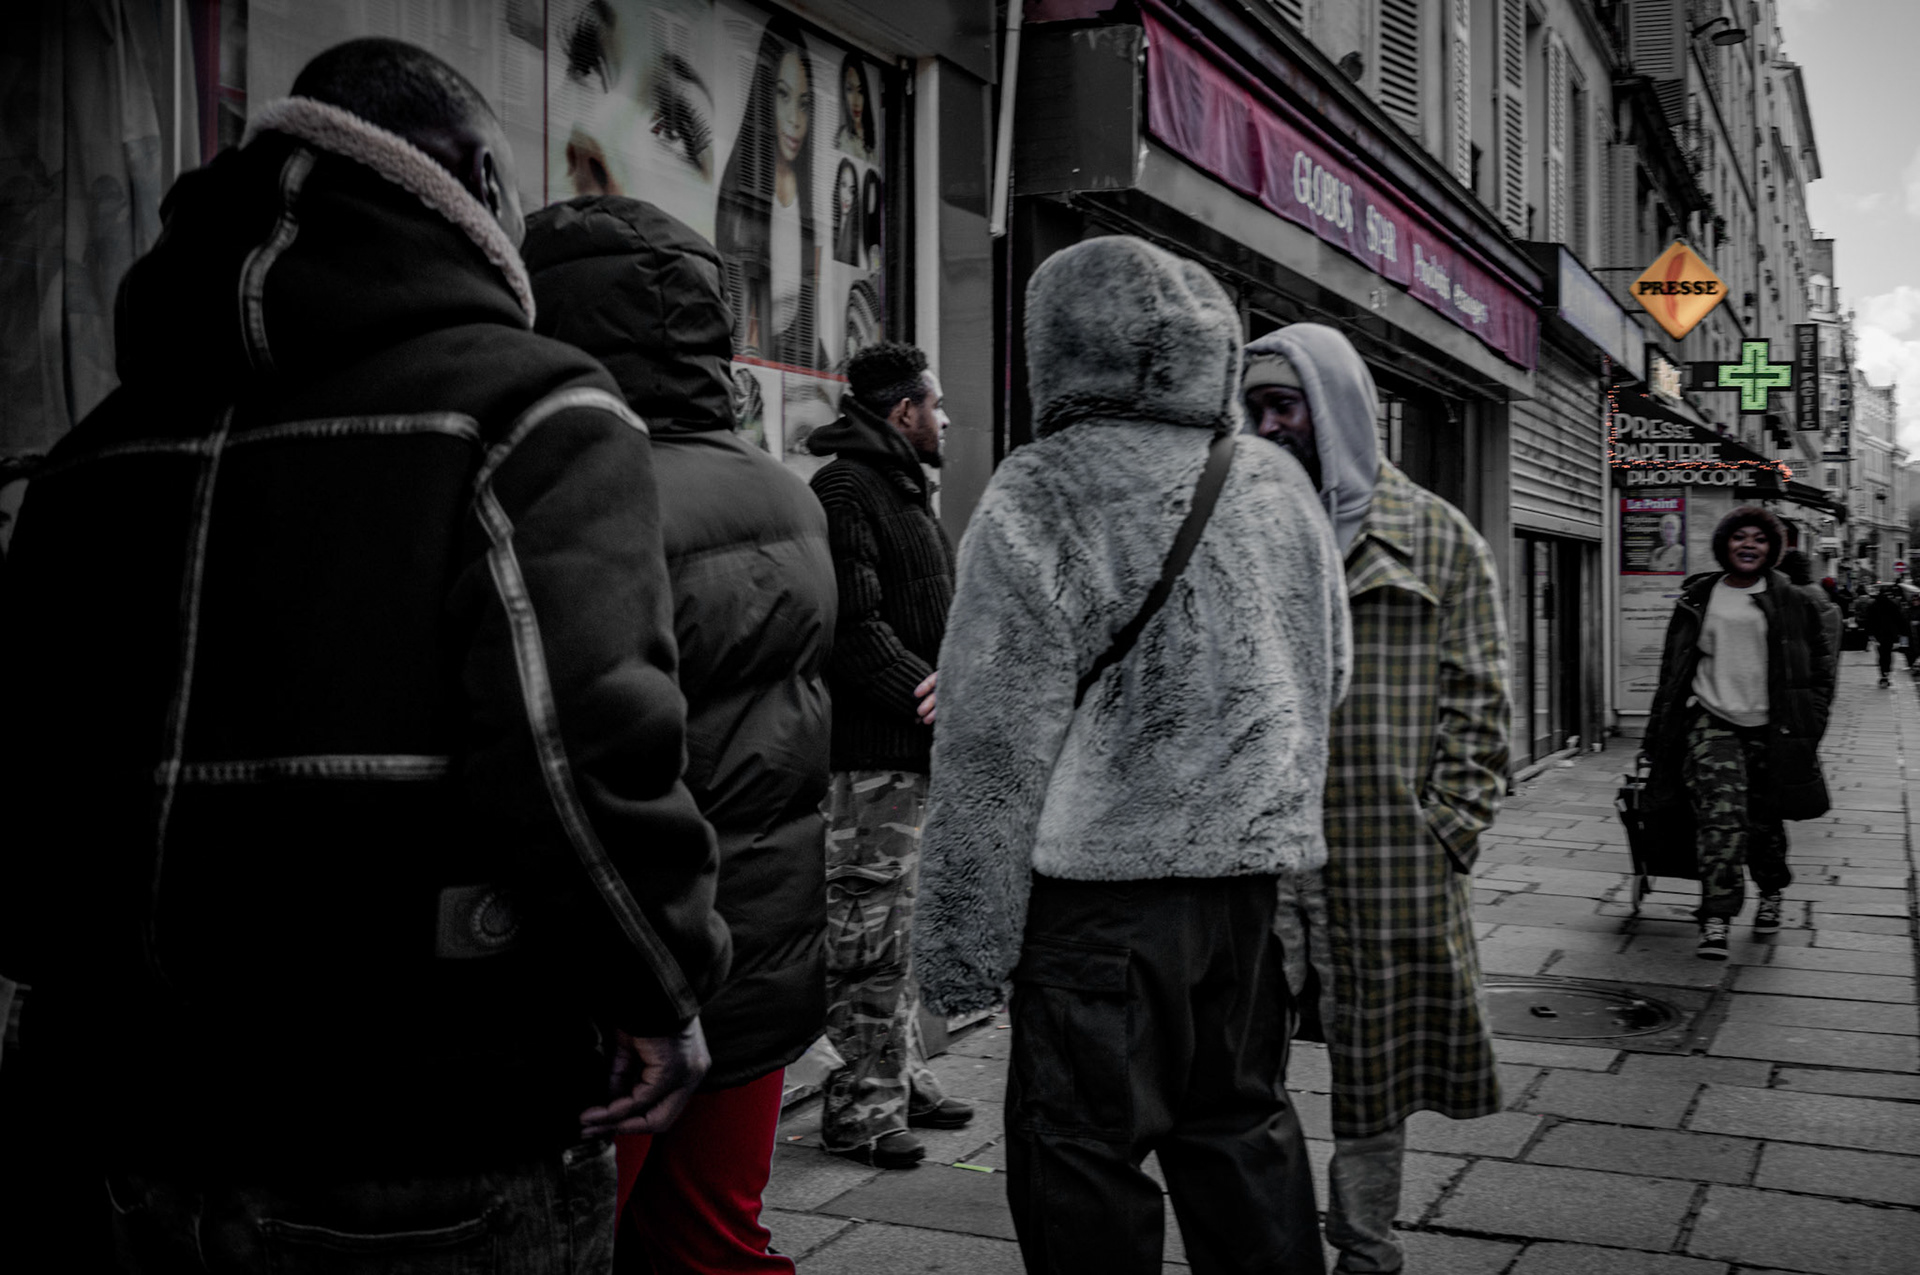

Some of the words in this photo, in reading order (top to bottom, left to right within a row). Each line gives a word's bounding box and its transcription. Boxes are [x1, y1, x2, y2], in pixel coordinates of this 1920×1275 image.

[1638, 281, 1718, 295] PRESSE
[1800, 372, 1815, 429] PACIFIC
[1614, 413, 1694, 439] PRESSE
[1627, 469, 1756, 486] PHOTOCOPIE
